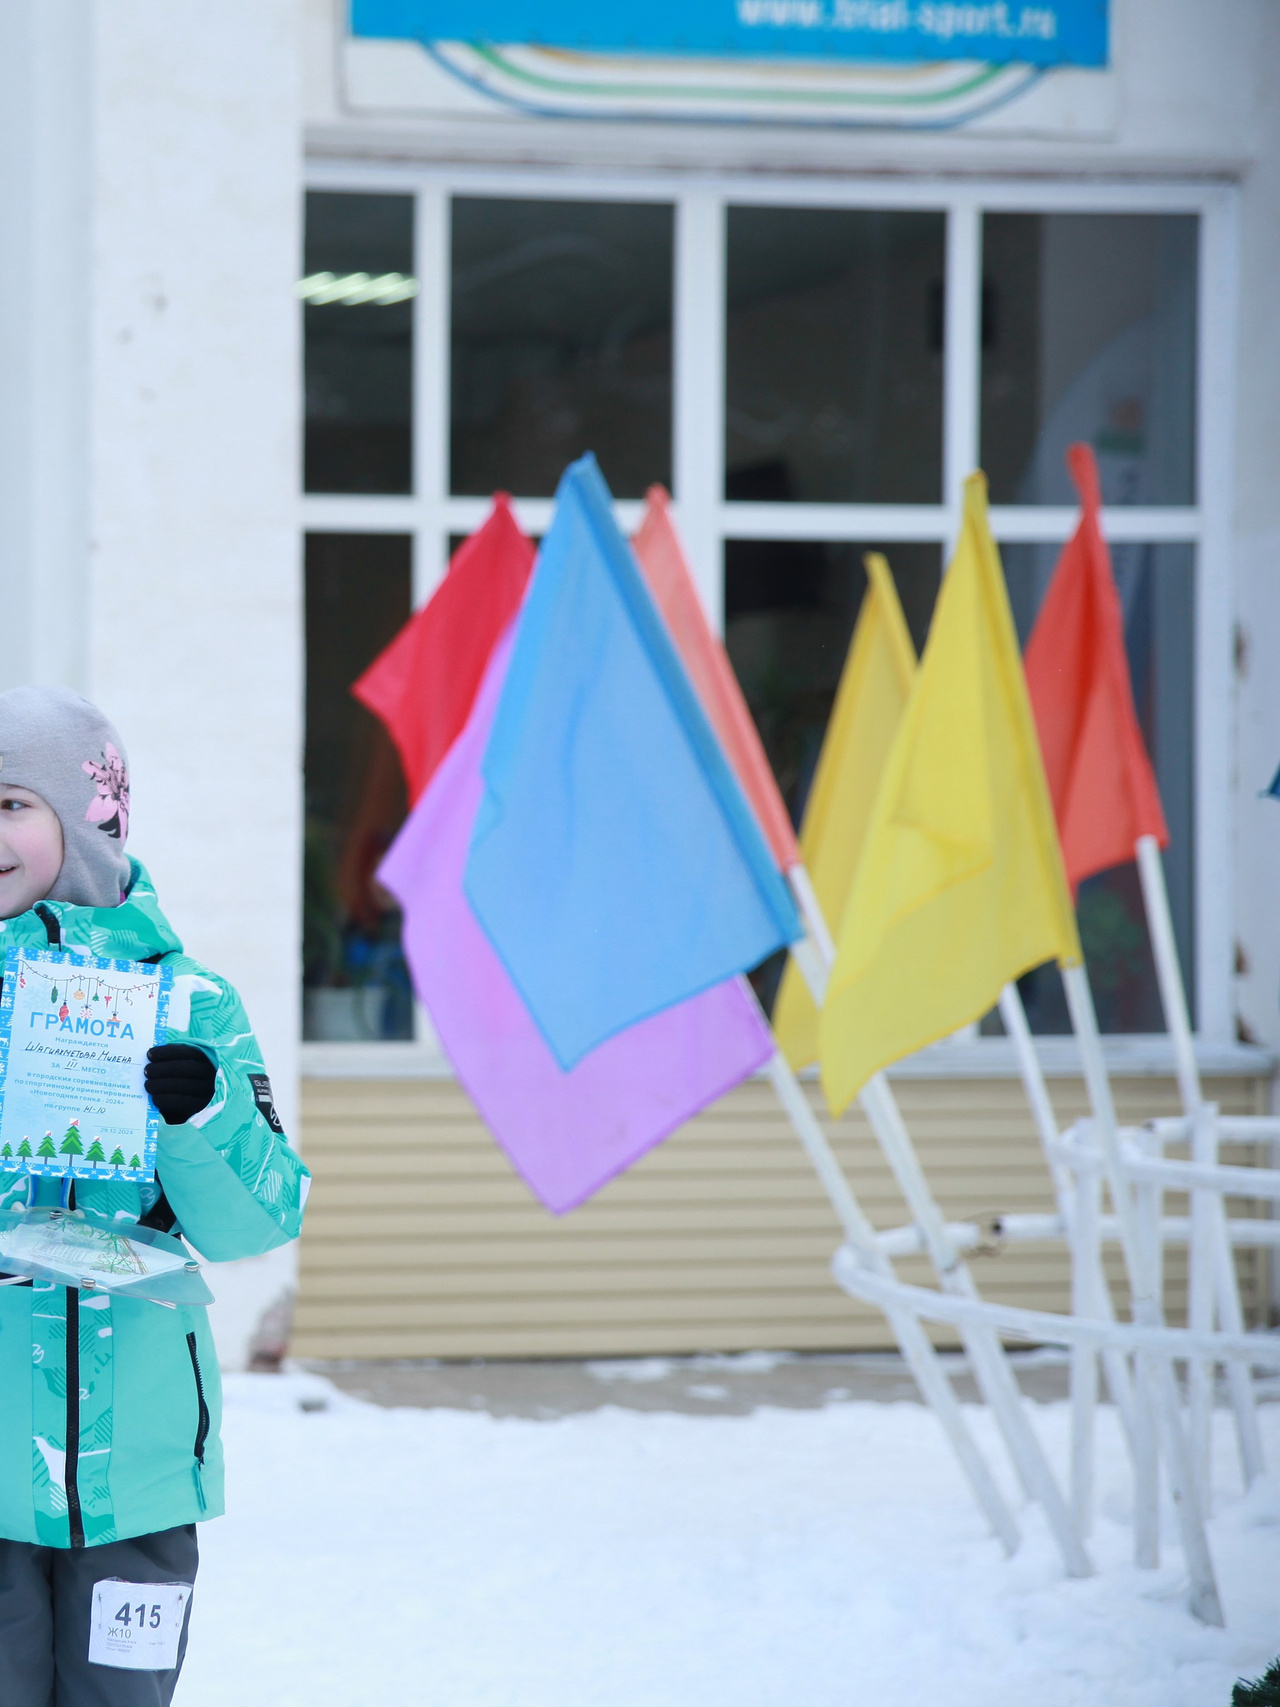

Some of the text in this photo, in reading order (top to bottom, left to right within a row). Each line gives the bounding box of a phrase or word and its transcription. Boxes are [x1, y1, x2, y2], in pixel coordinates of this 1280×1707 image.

[29, 1011, 135, 1040] ГРАМОТА
[55, 1036, 109, 1048] Награждается
[51, 1061, 61, 1069] ЗА
[81, 1065, 107, 1075] МЕСТО
[32, 1072, 71, 1081] городских
[72, 1078, 131, 1089] соревнованиях
[24, 1080, 75, 1092] спортивному
[75, 1087, 143, 1099] ориентированию
[79, 1095, 101, 1103] гонка
[54, 1104, 81, 1112] группе
[100, 1127, 134, 1135] 29.12.2024
[114, 1601, 162, 1629] 415
[107, 1626, 132, 1639] Ж10
